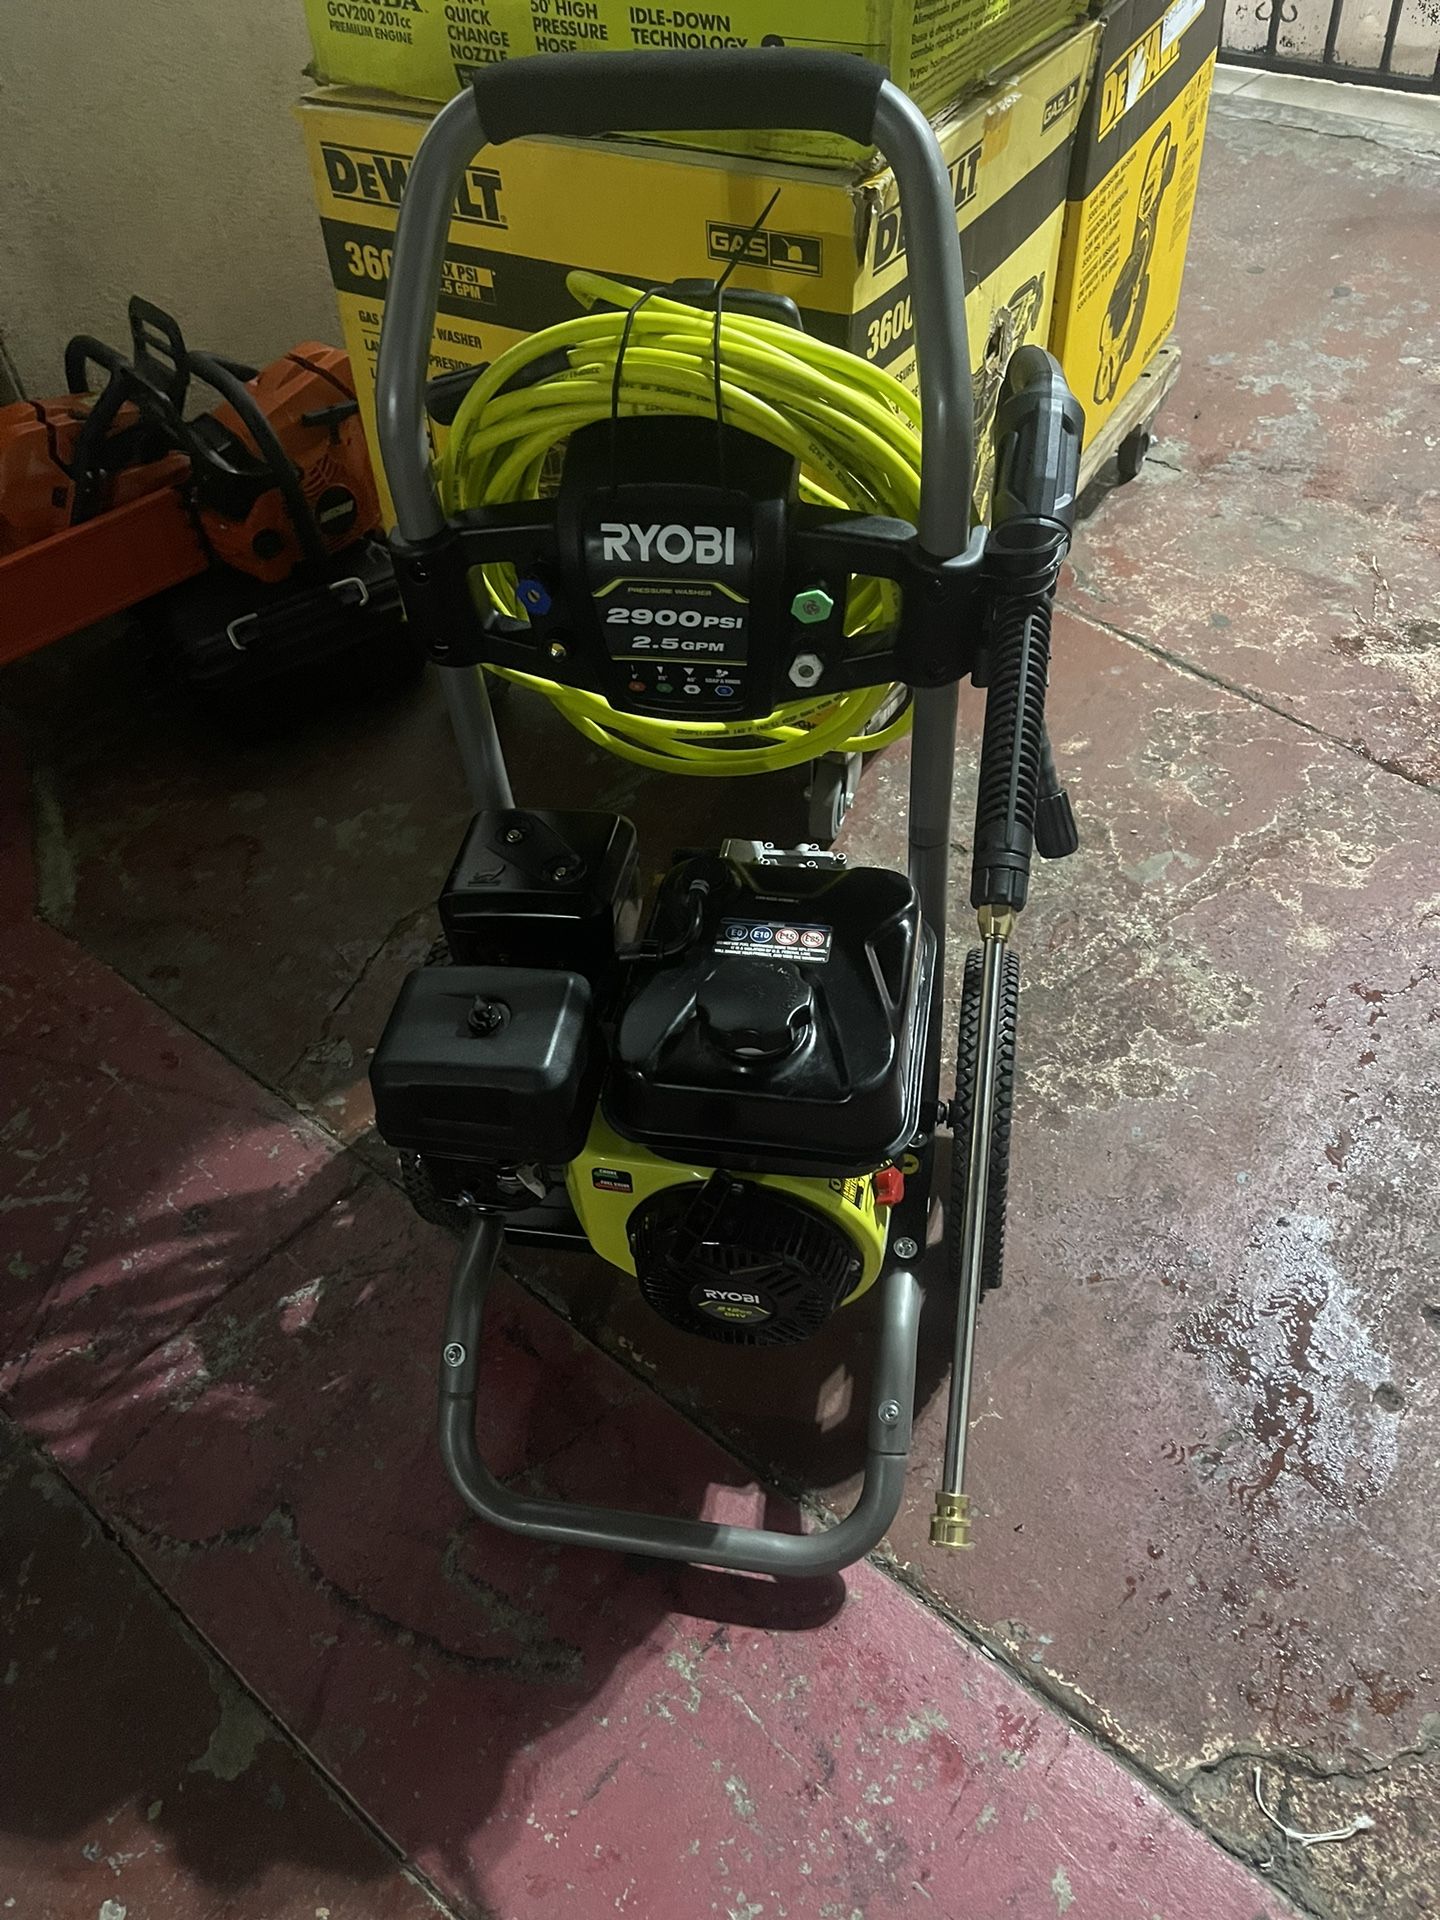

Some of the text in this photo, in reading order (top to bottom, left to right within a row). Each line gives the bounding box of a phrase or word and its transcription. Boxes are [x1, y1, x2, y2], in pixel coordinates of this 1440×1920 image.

[327, 1, 376, 24] GCV200
[378, 10, 412, 29] 201cc
[444, 5, 492, 26] QUICK
[555, 0, 598, 20] HIGH
[629, 6, 731, 33] IDLE-DOWN
[329, 20, 413, 45] PREMIUM ENGINE
[447, 25, 510, 47] CHANGE
[533, 16, 609, 41] PRESSURE
[630, 27, 749, 50] TECHNOLOGY
[450, 43, 509, 64] NOZZLE
[535, 36, 578, 54] HOSE
[1043, 94, 1065, 126] GAS
[321, 147, 503, 222] DEWLT
[711, 230, 767, 258] GAS
[456, 265, 479, 283] PSI
[455, 284, 481, 300] GPM
[358, 310, 379, 325] GAS
[436, 328, 482, 349] WASHER
[600, 522, 736, 566] RYOBI
[627, 587, 712, 597] PRESSURE WASHER
[753, 930, 770, 939] E10
[703, 1288, 760, 1304] RYOBI
